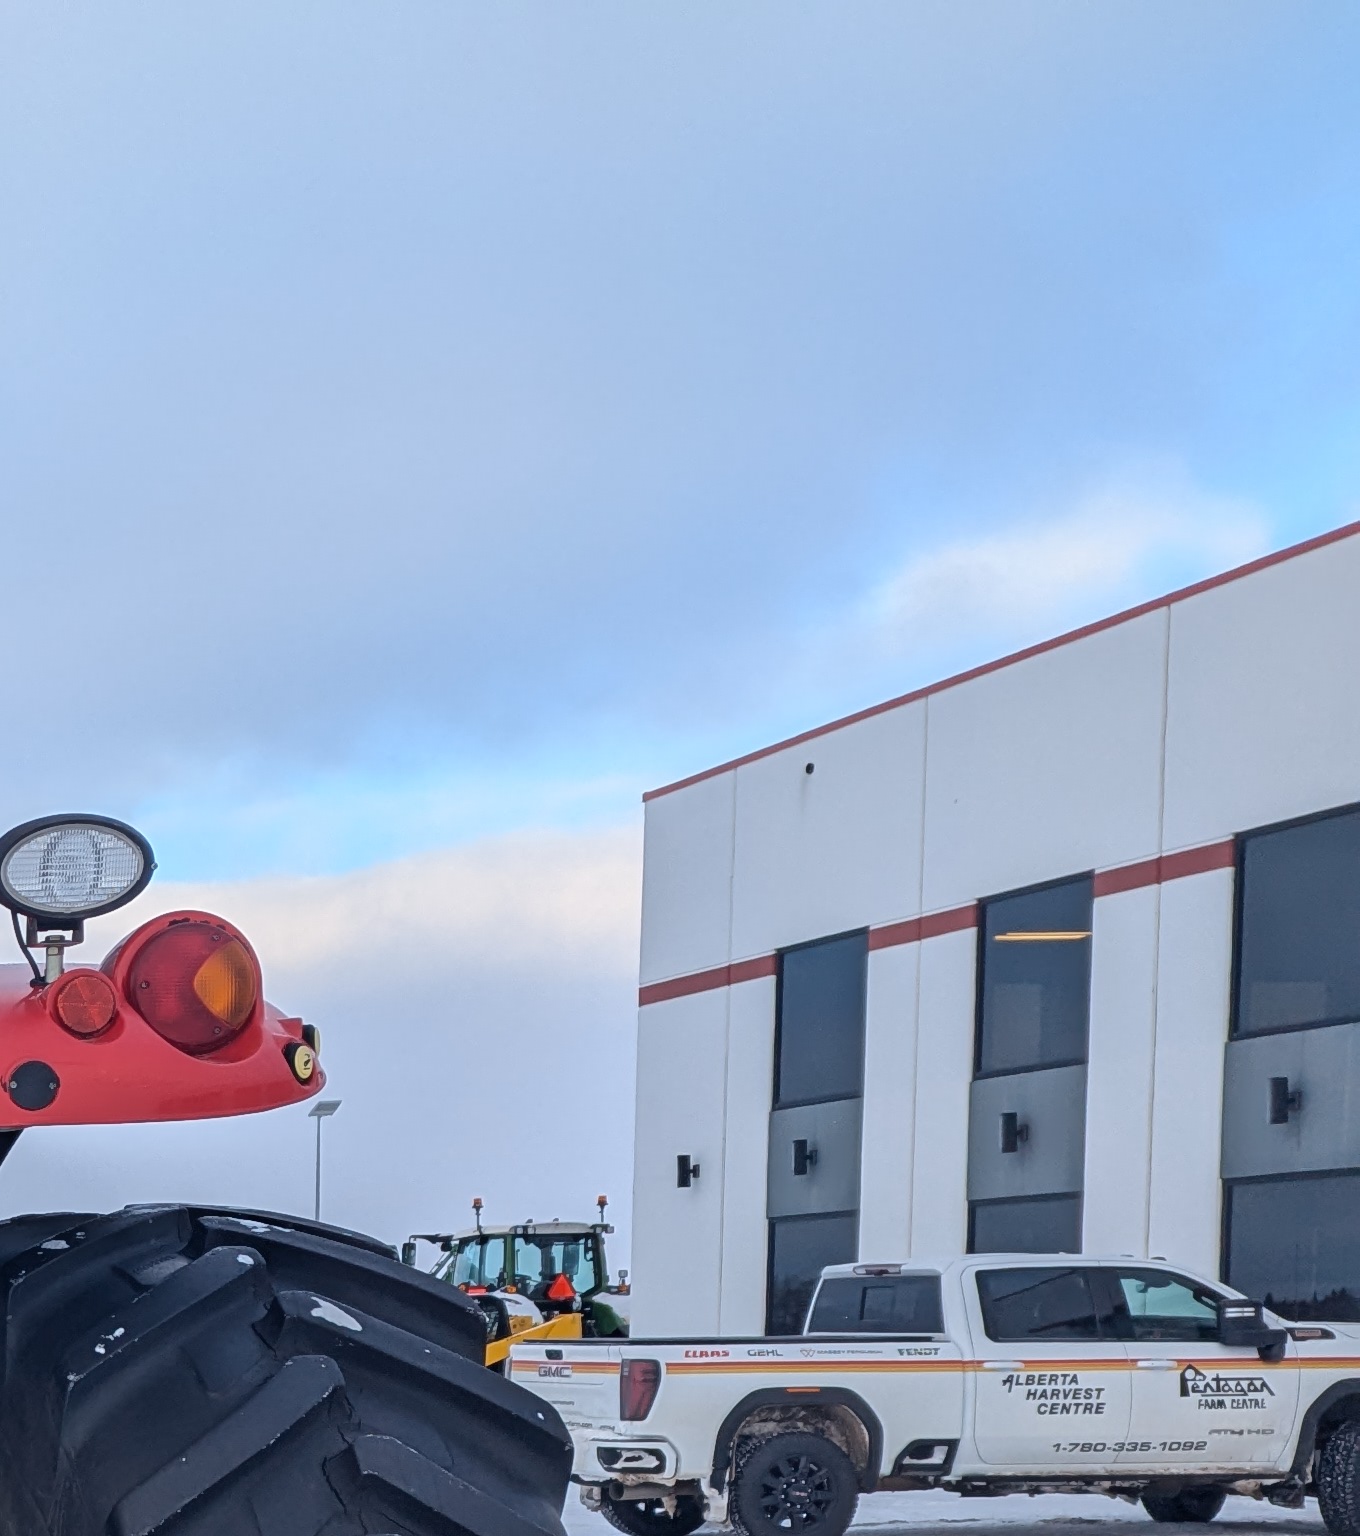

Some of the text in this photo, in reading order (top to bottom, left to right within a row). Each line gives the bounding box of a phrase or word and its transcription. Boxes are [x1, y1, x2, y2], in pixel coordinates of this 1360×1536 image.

[684, 1349, 730, 1359] CLAAS
[747, 1348, 784, 1357] GEHL
[896, 1347, 941, 1356] FENDT
[538, 1365, 573, 1378] GMC
[1001, 1373, 1080, 1393] ALBERTA
[1180, 1363, 1276, 1398] Pentagon
[1025, 1387, 1106, 1401] HARVEST
[1036, 1402, 1107, 1416] CENTRE
[1197, 1397, 1267, 1410] FARM CENTRE
[1051, 1440, 1208, 1453] 1-780-335-1092
